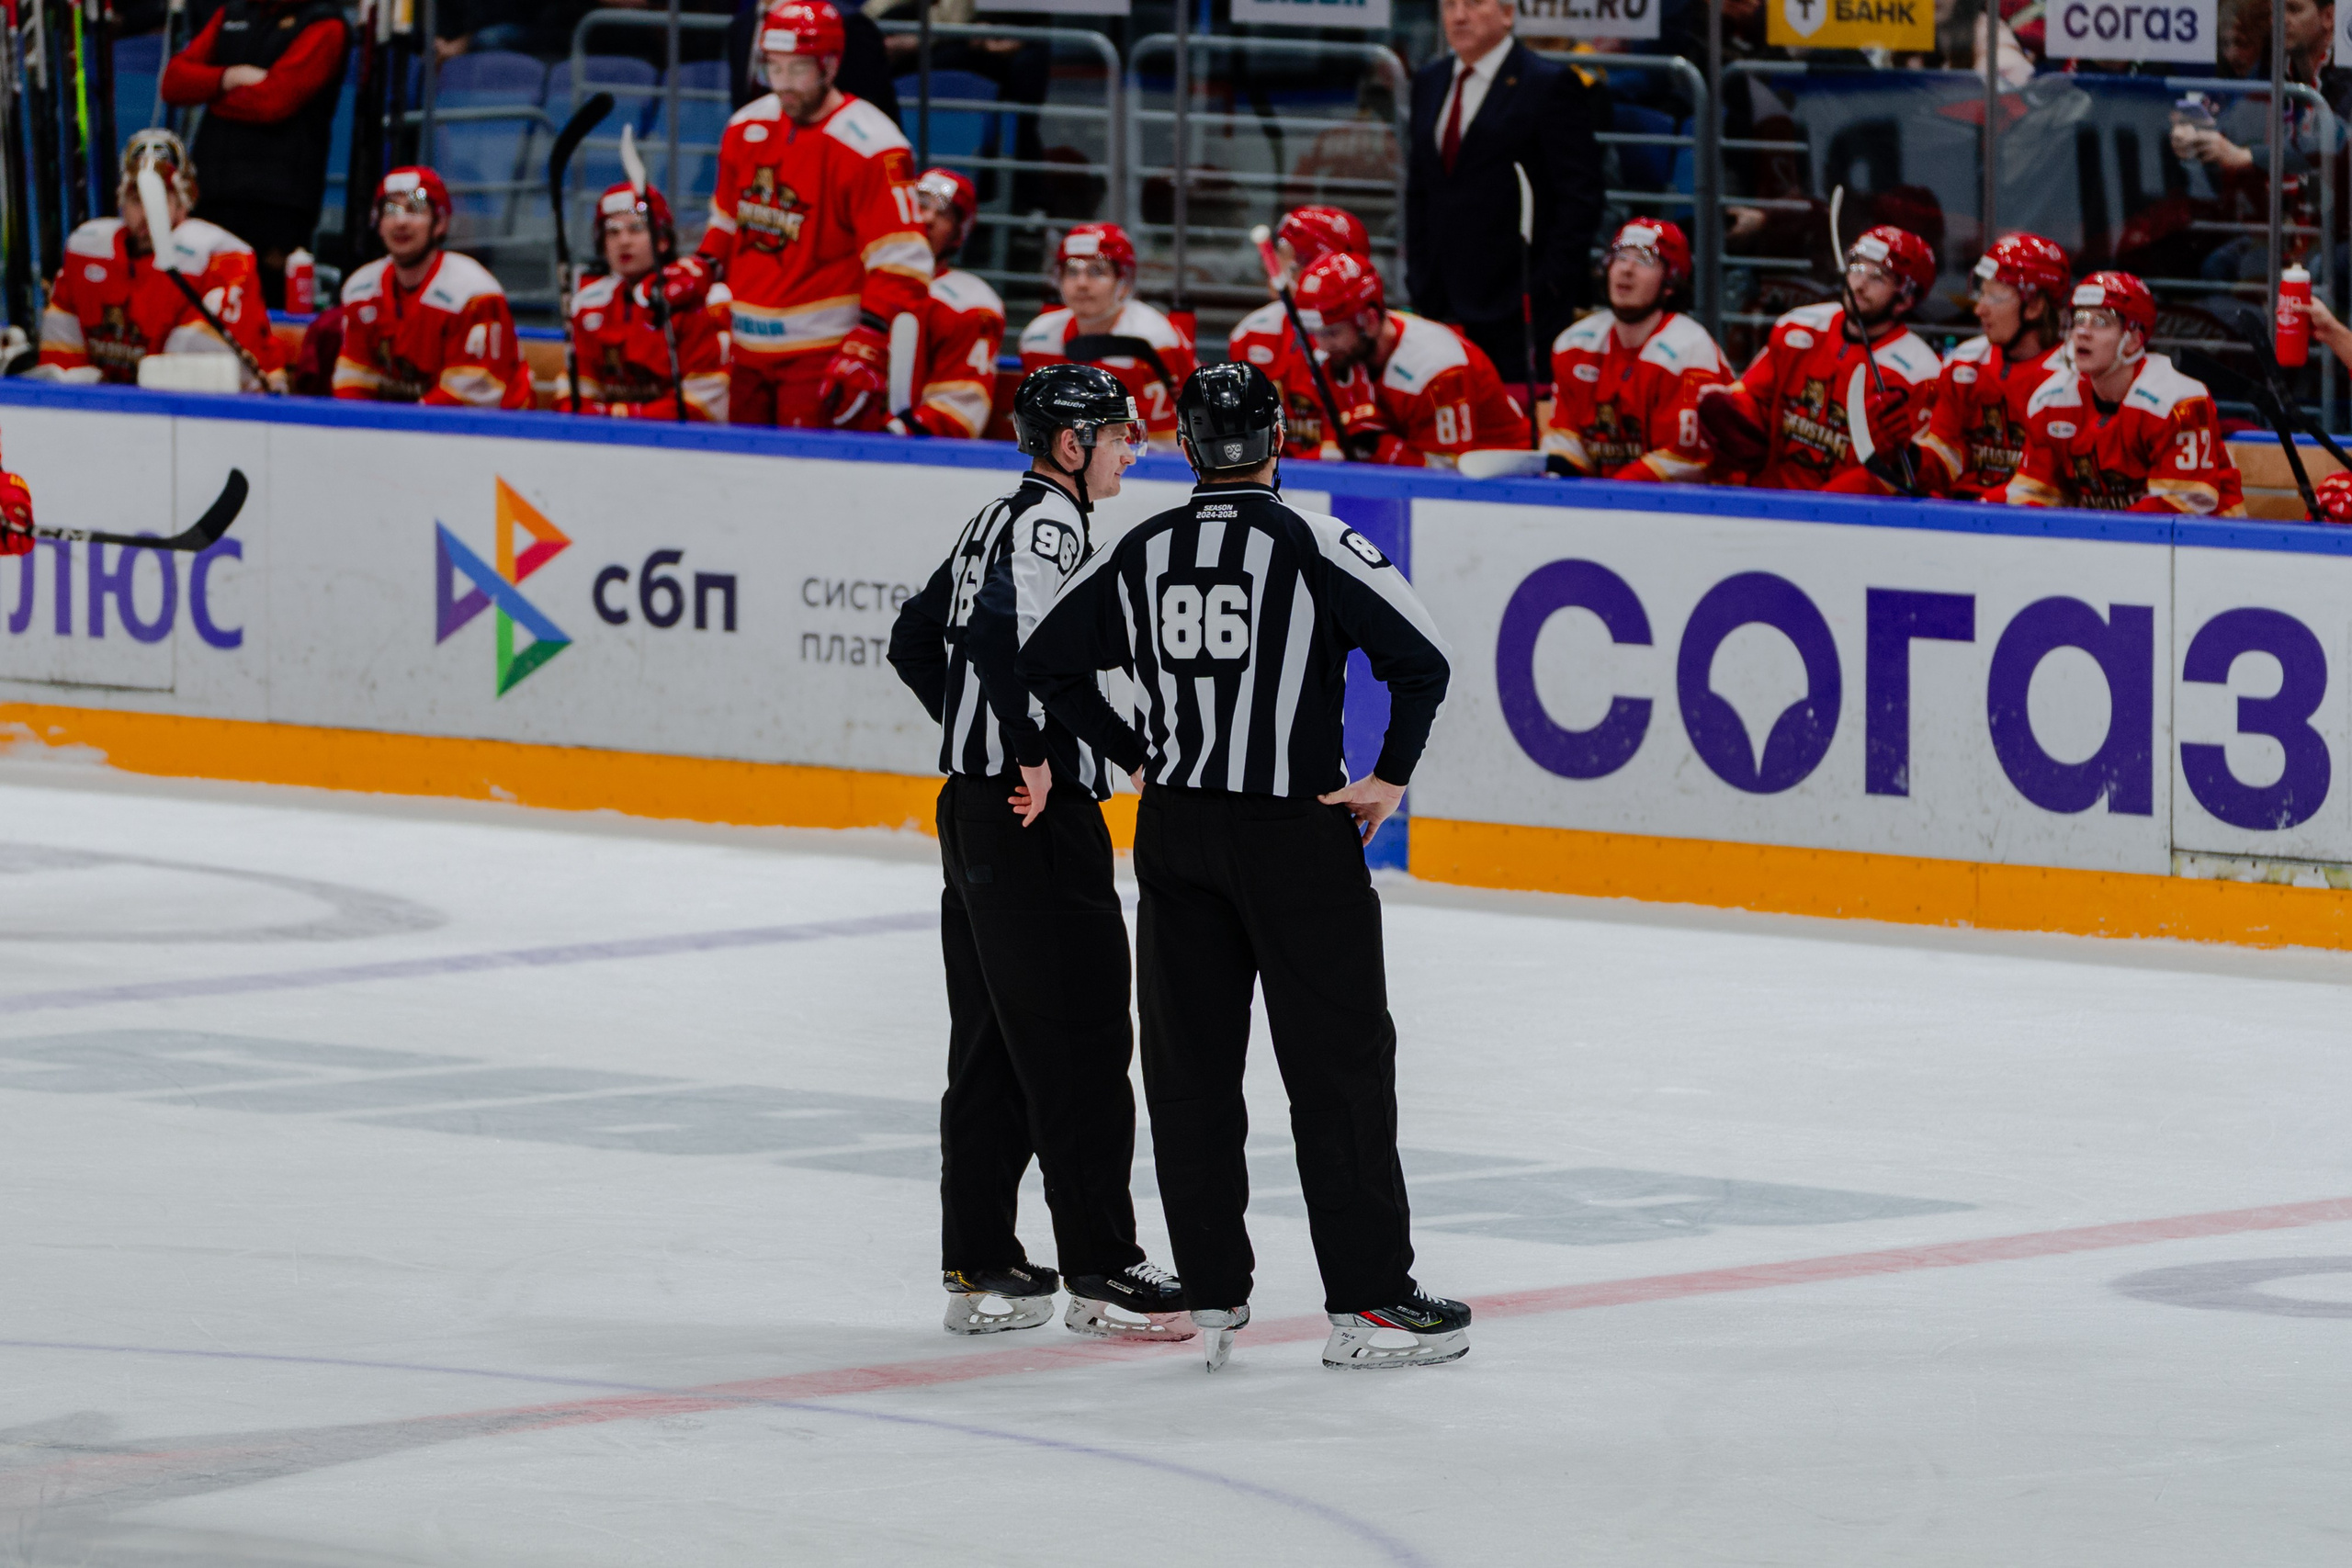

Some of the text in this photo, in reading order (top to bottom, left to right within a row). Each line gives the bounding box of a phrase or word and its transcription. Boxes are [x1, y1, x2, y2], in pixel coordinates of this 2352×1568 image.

[1435, 401, 1473, 446] 81
[2174, 429, 2215, 471] 32
[1196, 511, 1238, 519] 2024-2025
[1035, 523, 1079, 572] 96
[593, 548, 737, 633] сбп
[801, 577, 922, 613] систе
[1161, 584, 1250, 660] 86
[801, 632, 891, 667] плат
